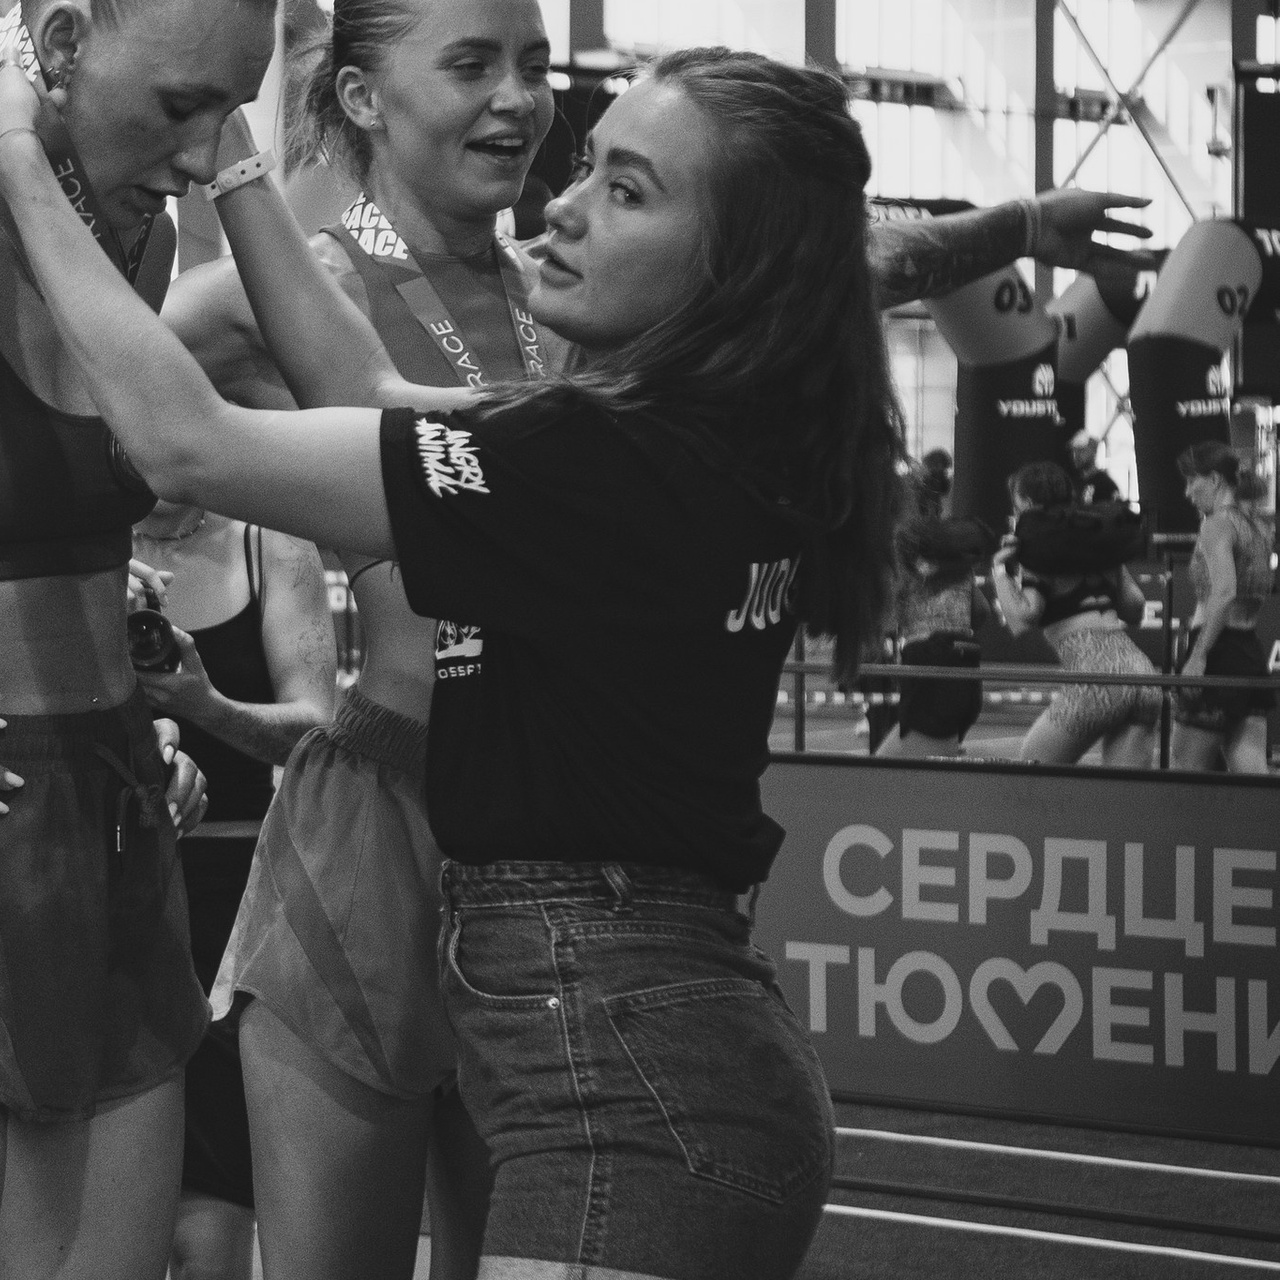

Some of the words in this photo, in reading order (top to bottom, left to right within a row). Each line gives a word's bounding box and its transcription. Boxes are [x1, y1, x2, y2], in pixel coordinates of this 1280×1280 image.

[444, 425, 491, 494] ANGRY
[725, 552, 802, 634] JUD
[821, 823, 1277, 958] СЕРДЦЕ
